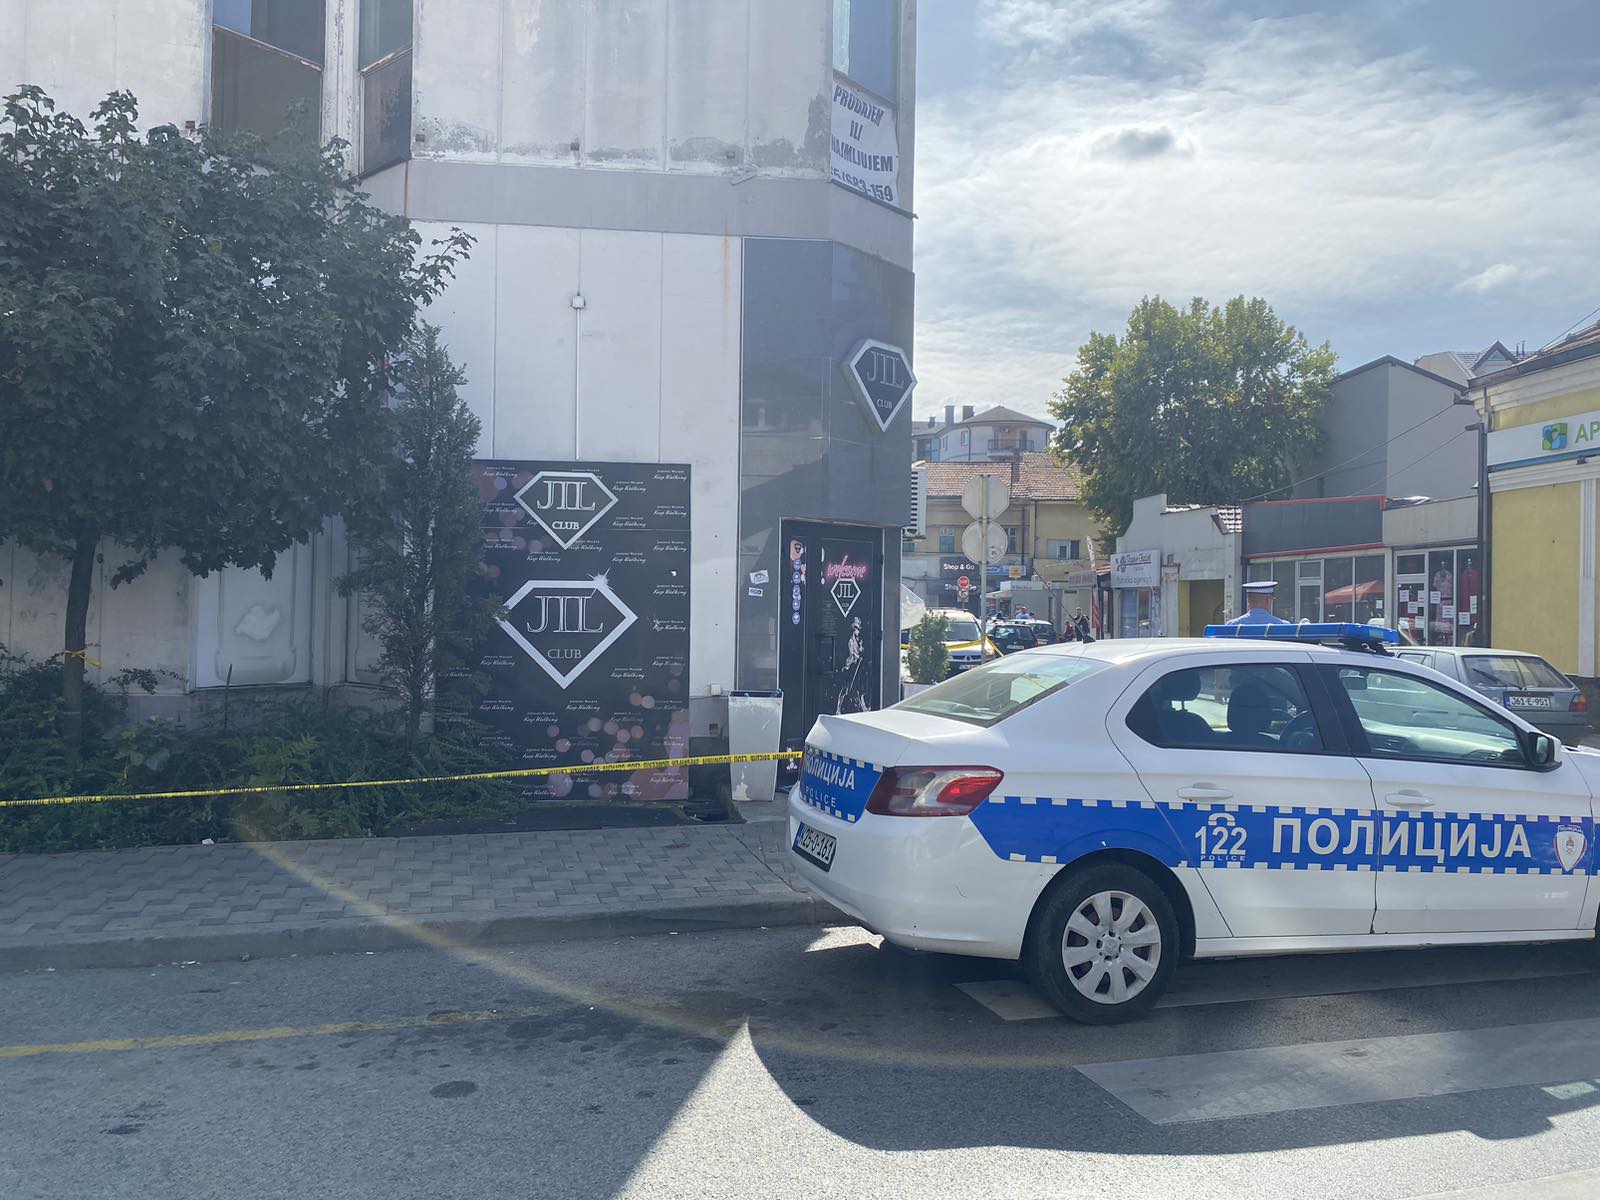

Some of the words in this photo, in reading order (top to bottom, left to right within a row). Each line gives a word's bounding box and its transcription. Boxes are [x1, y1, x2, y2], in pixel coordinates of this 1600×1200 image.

[850, 119, 863, 141] ILI
[536, 480, 596, 511] JIL
[552, 521, 580, 530] CLUB
[943, 563, 959, 571] Shop
[526, 596, 604, 633] JIL
[547, 648, 582, 659] CLUB
[805, 785, 837, 808] POLICE
[1195, 826, 1248, 855] 122
[1272, 817, 1531, 863] ПОЛИЦИЈА
